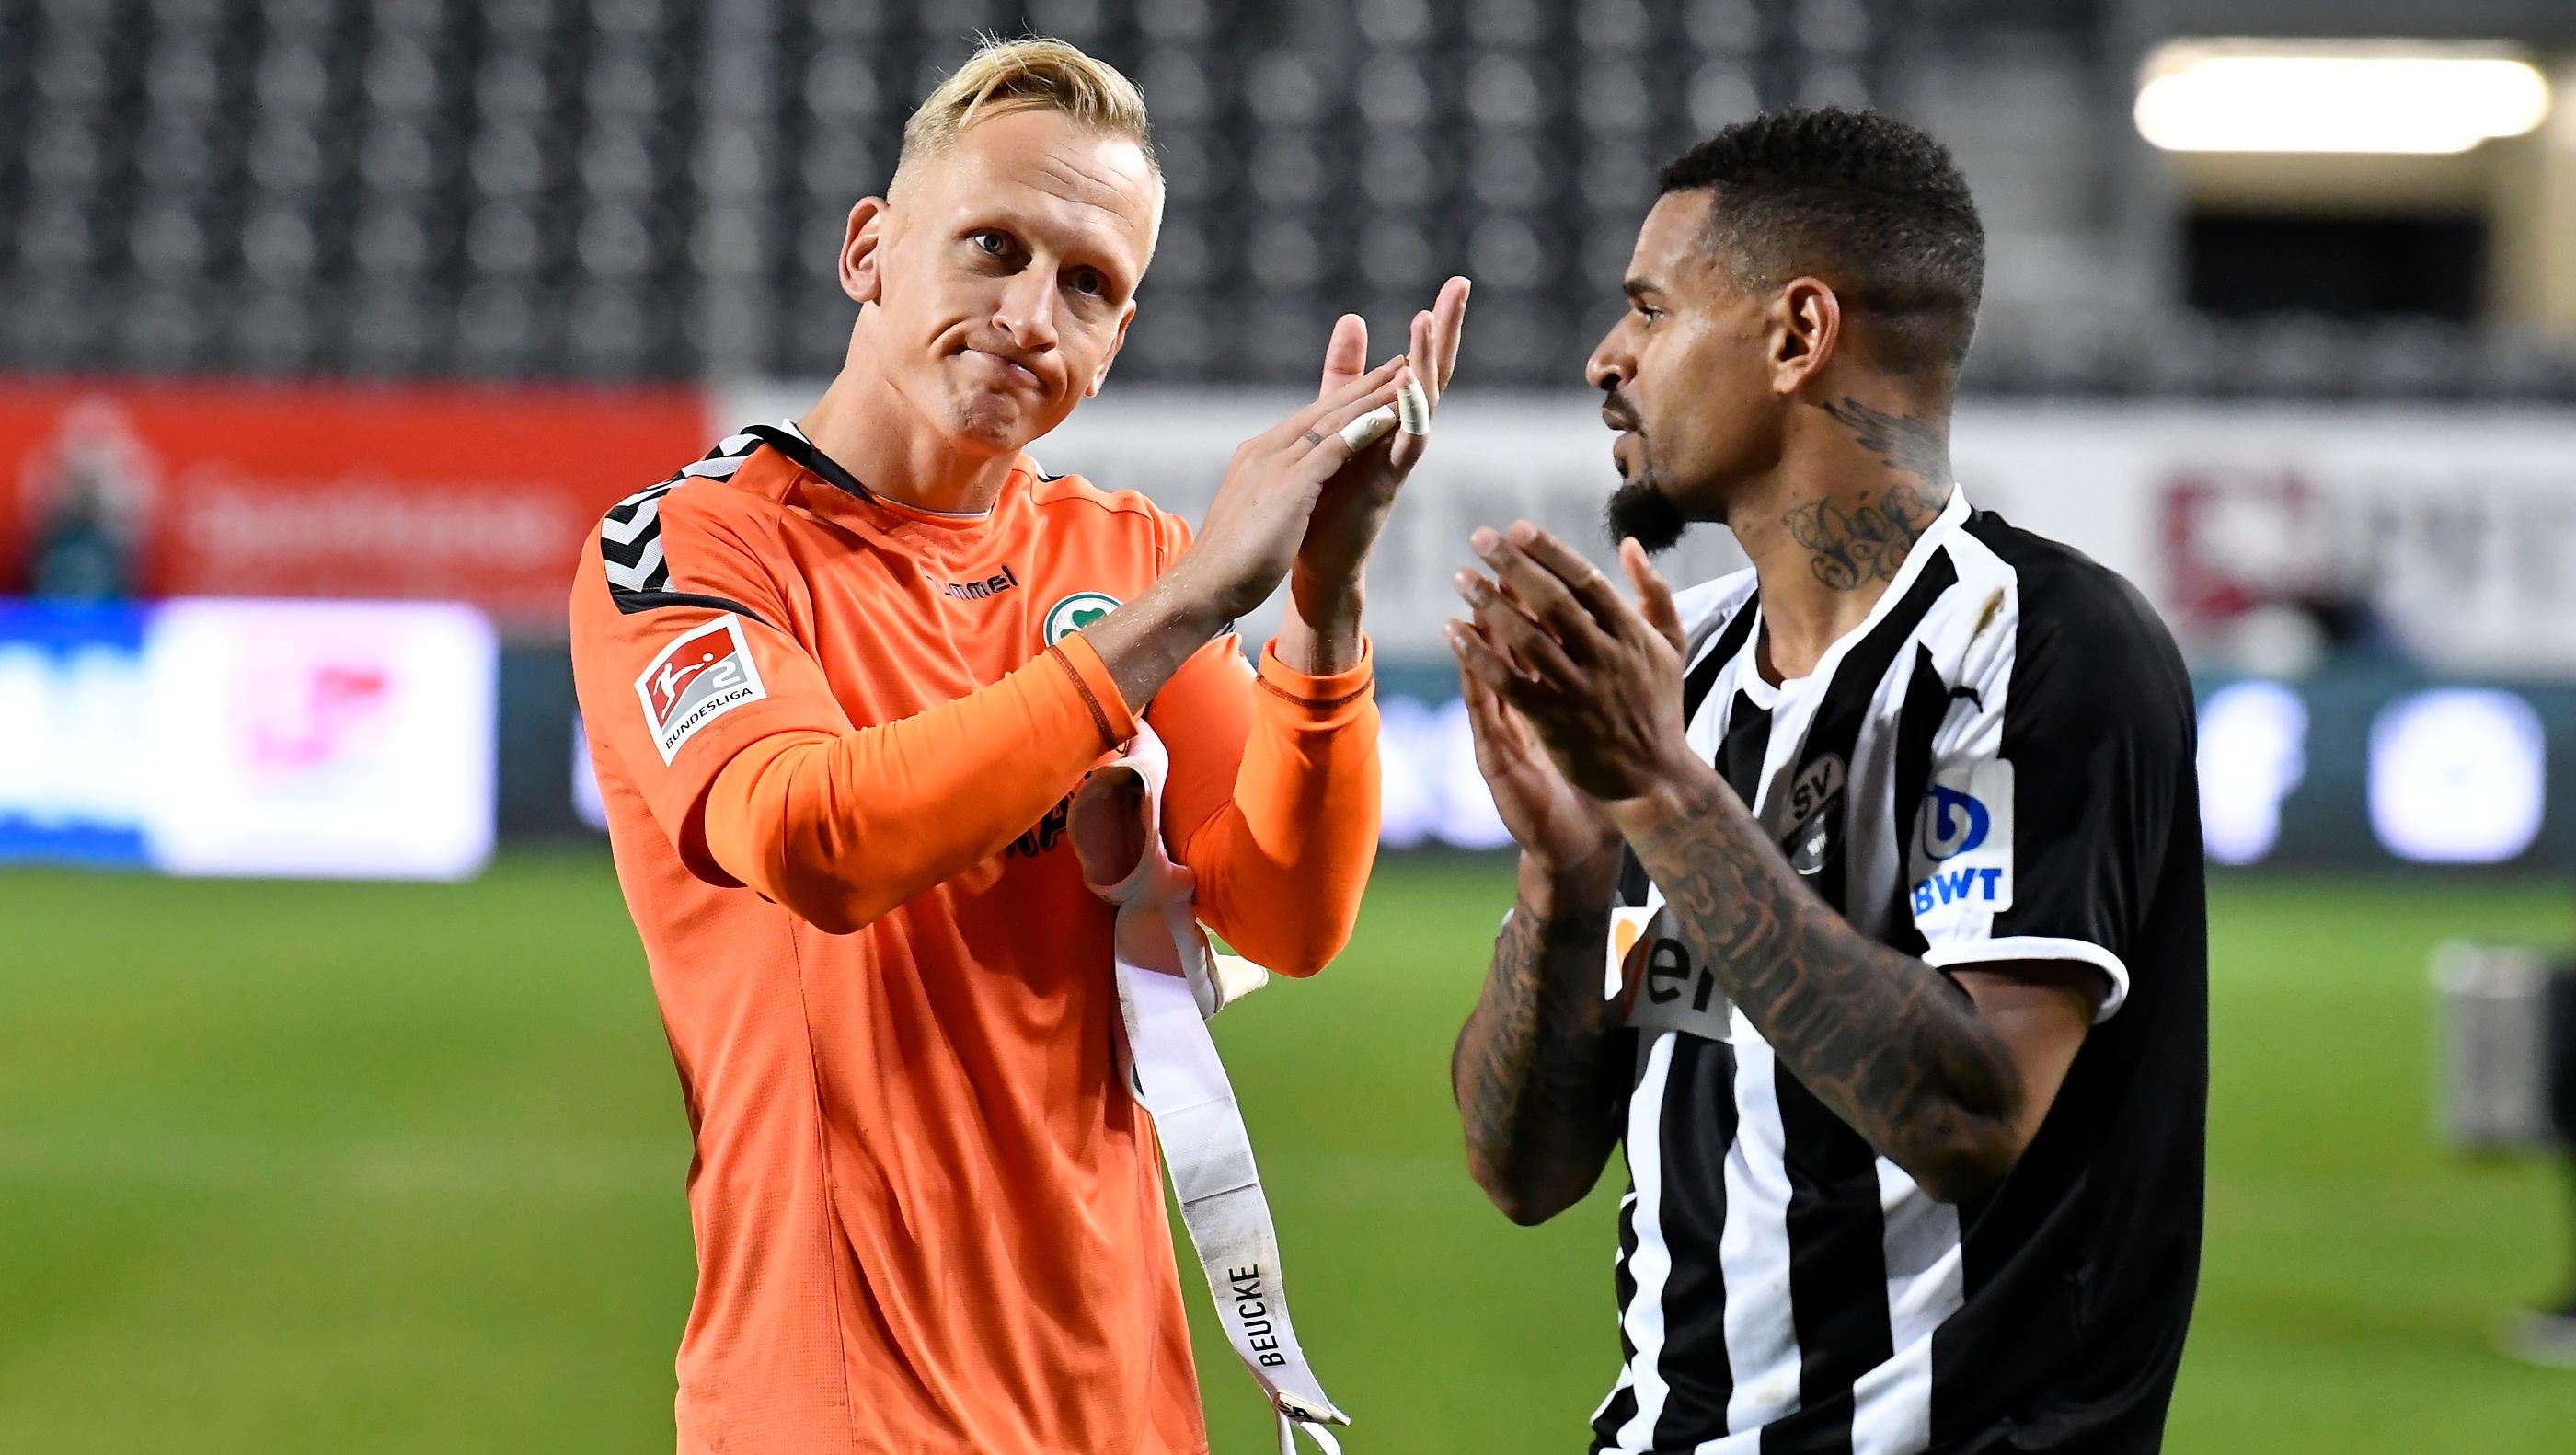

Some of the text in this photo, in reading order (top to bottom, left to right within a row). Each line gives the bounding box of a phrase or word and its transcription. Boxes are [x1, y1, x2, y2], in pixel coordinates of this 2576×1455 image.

[709, 661, 741, 688] 2
[665, 687, 753, 749] BUNDESLIGA
[1793, 761, 1831, 820] SV
[1915, 868, 2002, 917] BWT
[1228, 1264, 1286, 1367] BEUCKE
